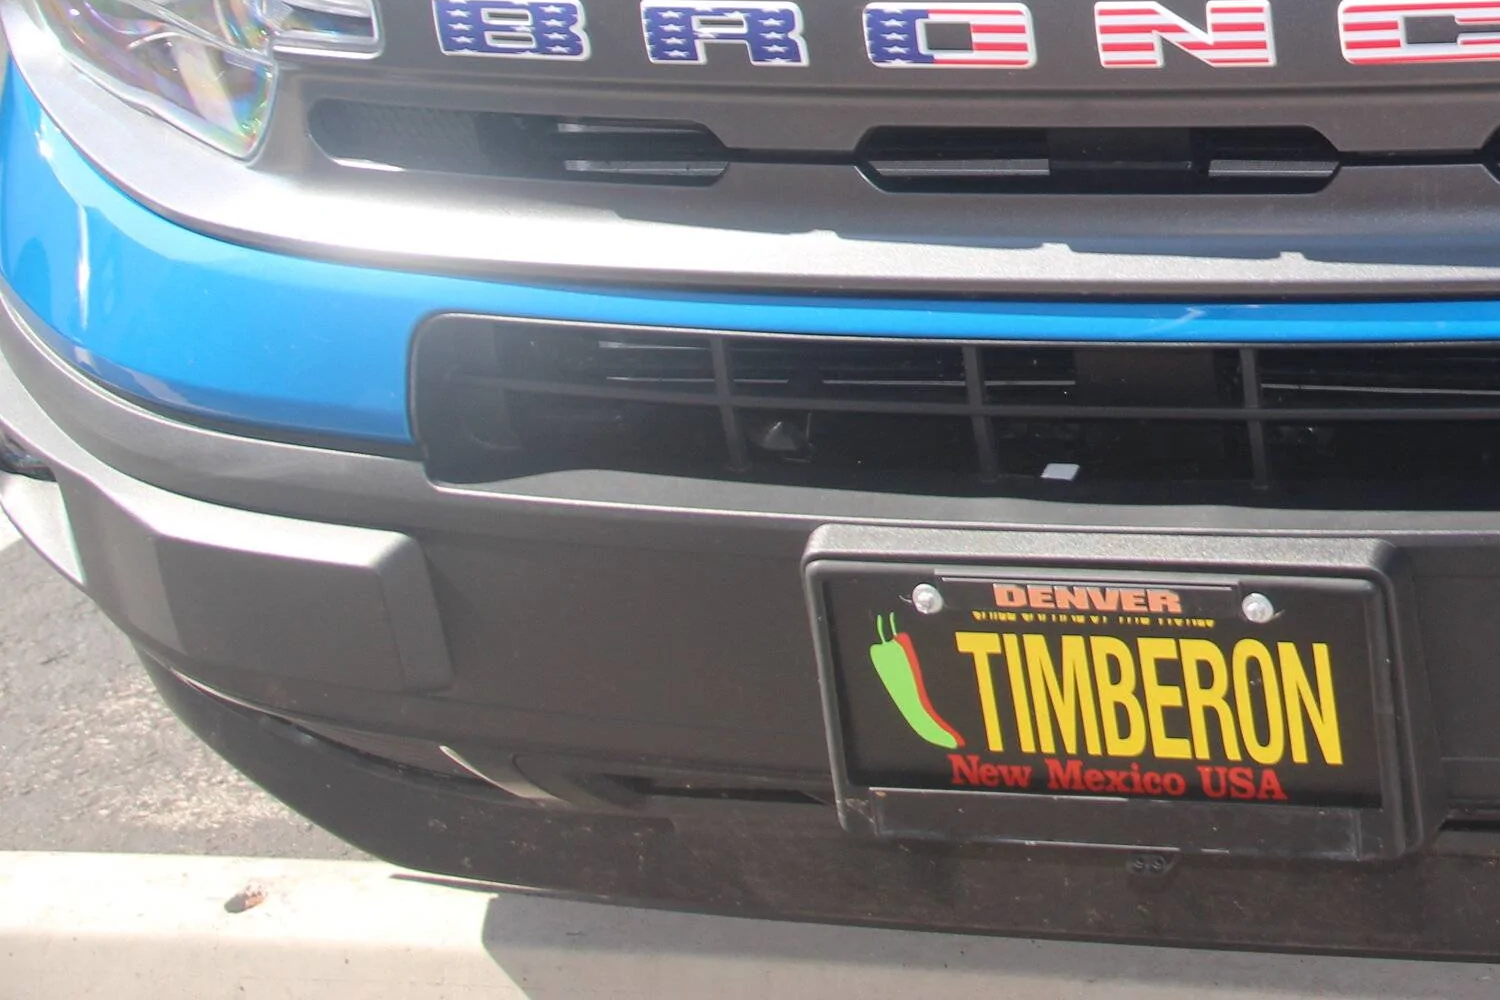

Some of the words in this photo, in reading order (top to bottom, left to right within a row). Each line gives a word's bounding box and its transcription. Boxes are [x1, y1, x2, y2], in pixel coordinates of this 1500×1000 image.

[992, 583, 1182, 614] DENVER
[955, 631, 1344, 766] TIMBERON
[948, 754, 1033, 788] New
[1044, 758, 1187, 796] Mexico
[1196, 765, 1288, 800] USA
